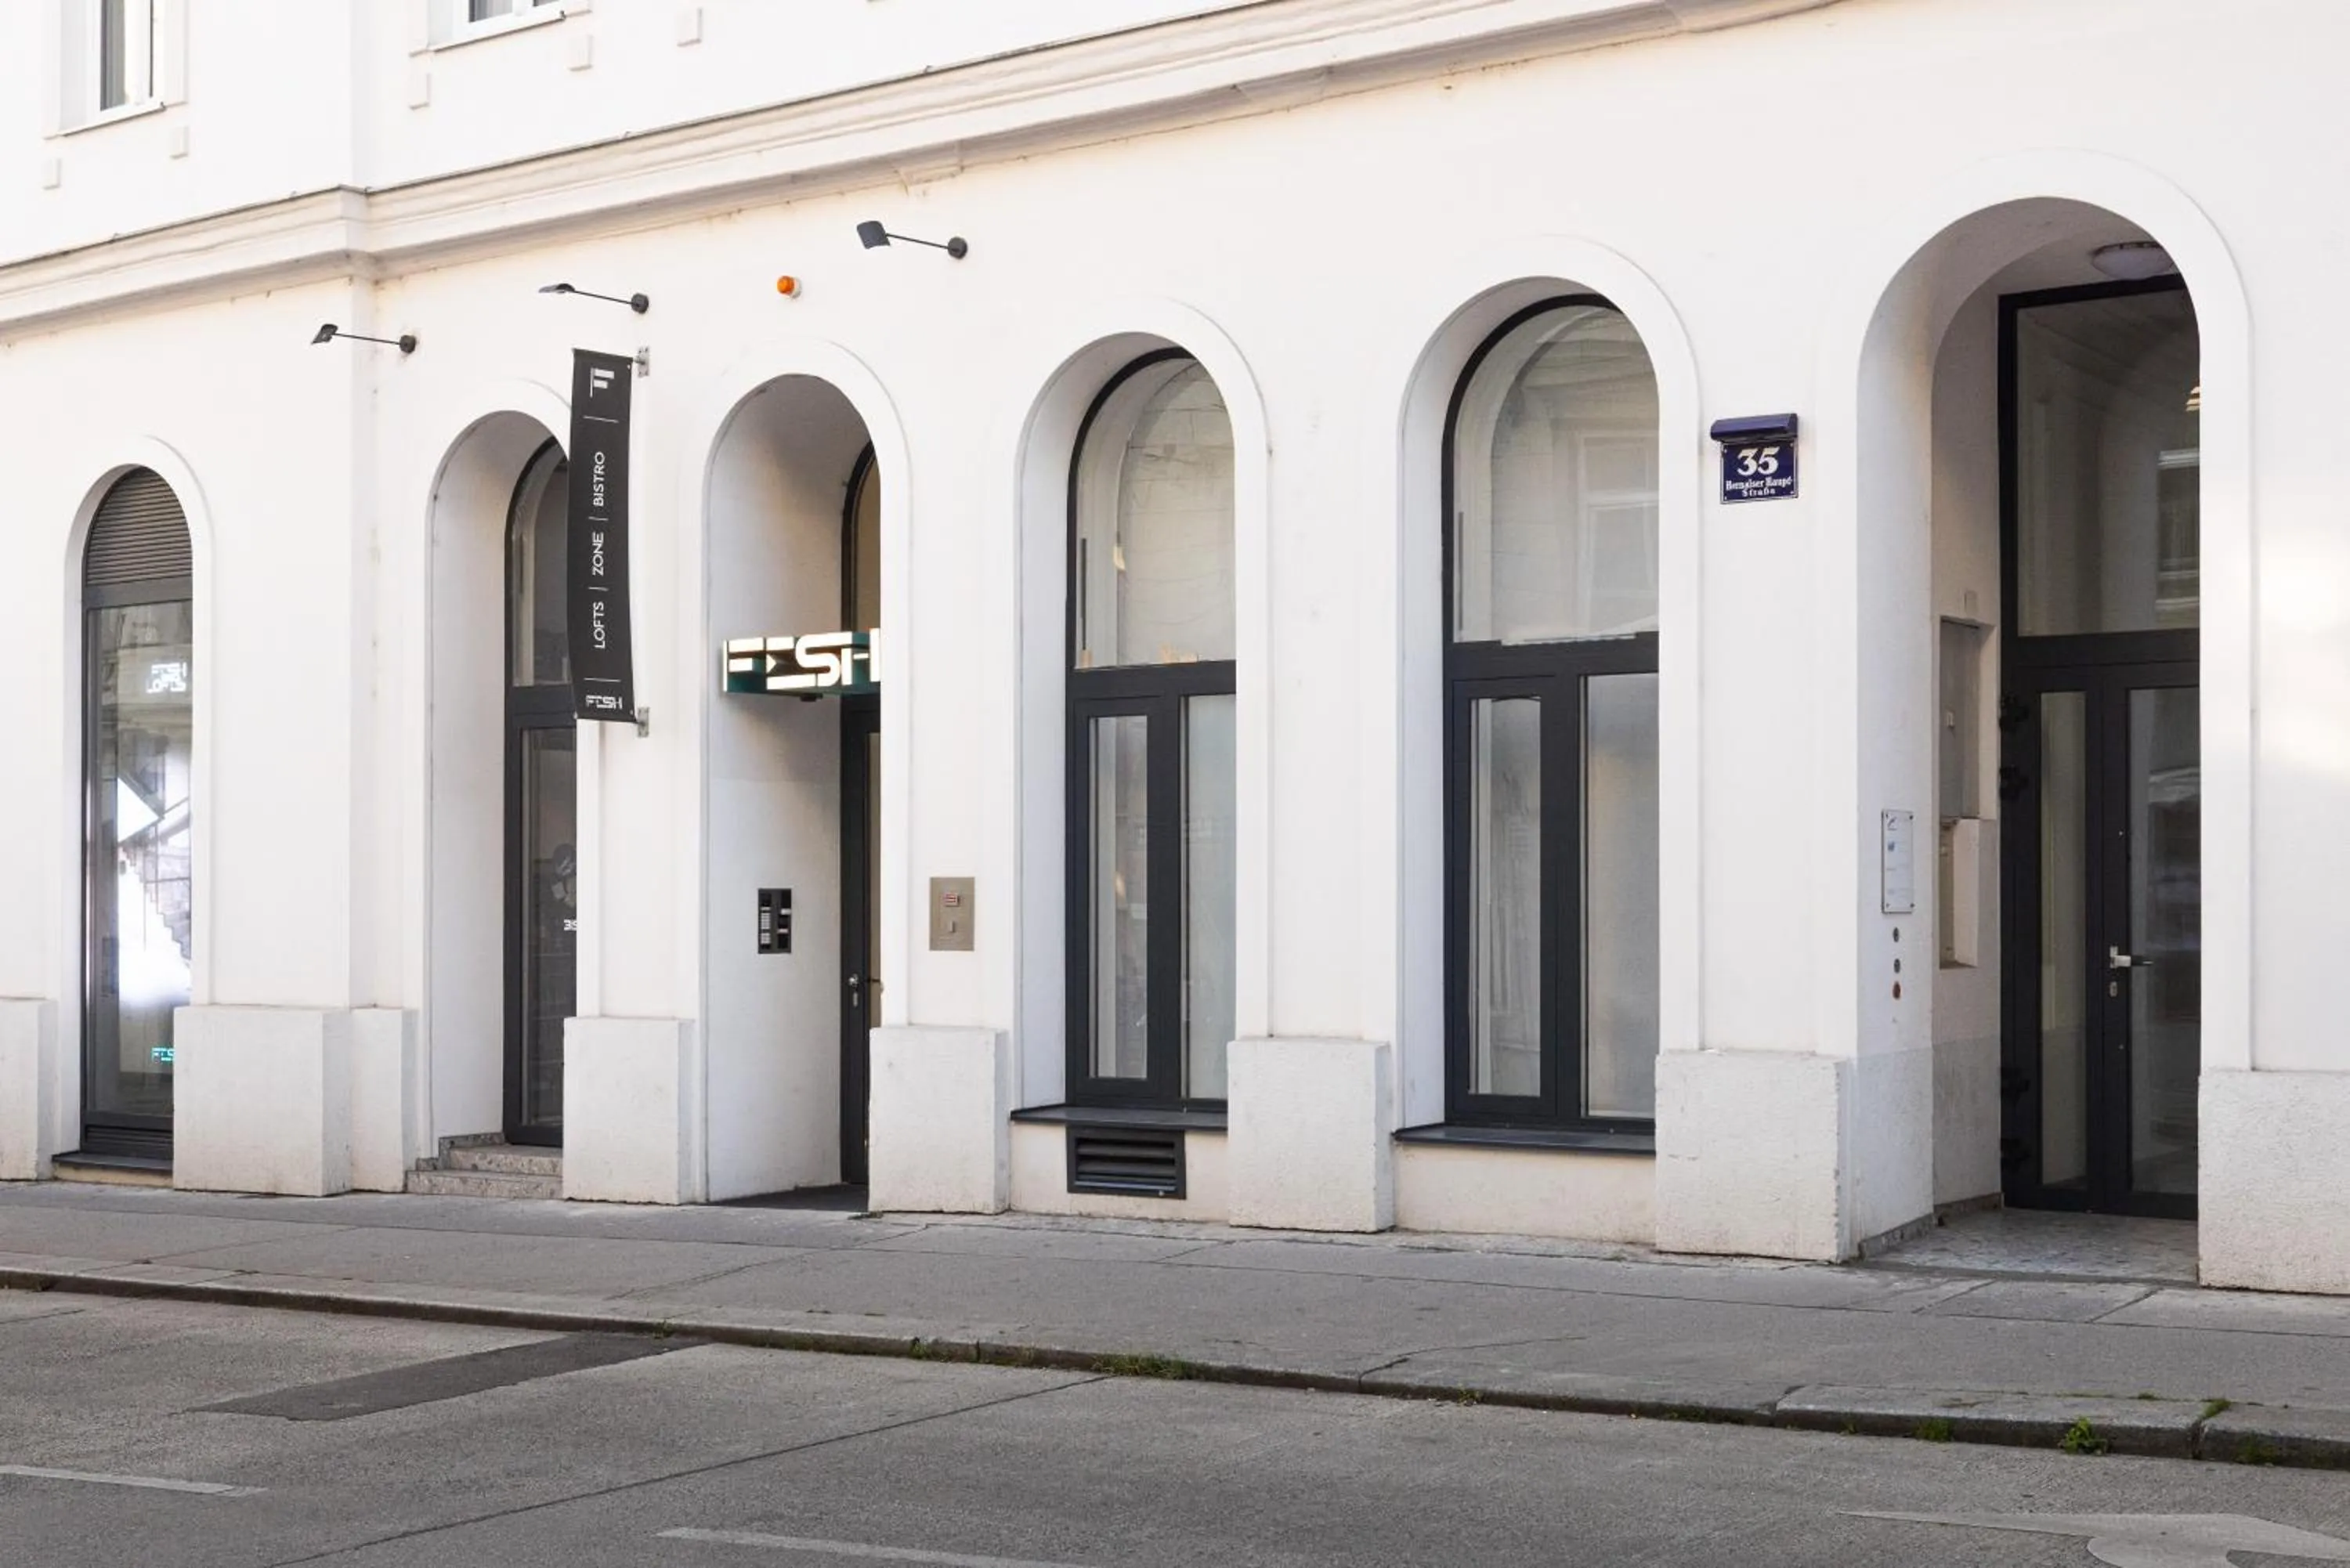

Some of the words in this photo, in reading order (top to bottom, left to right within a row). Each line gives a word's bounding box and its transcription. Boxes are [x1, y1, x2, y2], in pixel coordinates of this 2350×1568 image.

[593, 451, 606, 507] BISTRO
[1737, 446, 1780, 476] 35
[591, 532, 604, 576] ZONE
[593, 601, 606, 649] LOFTS
